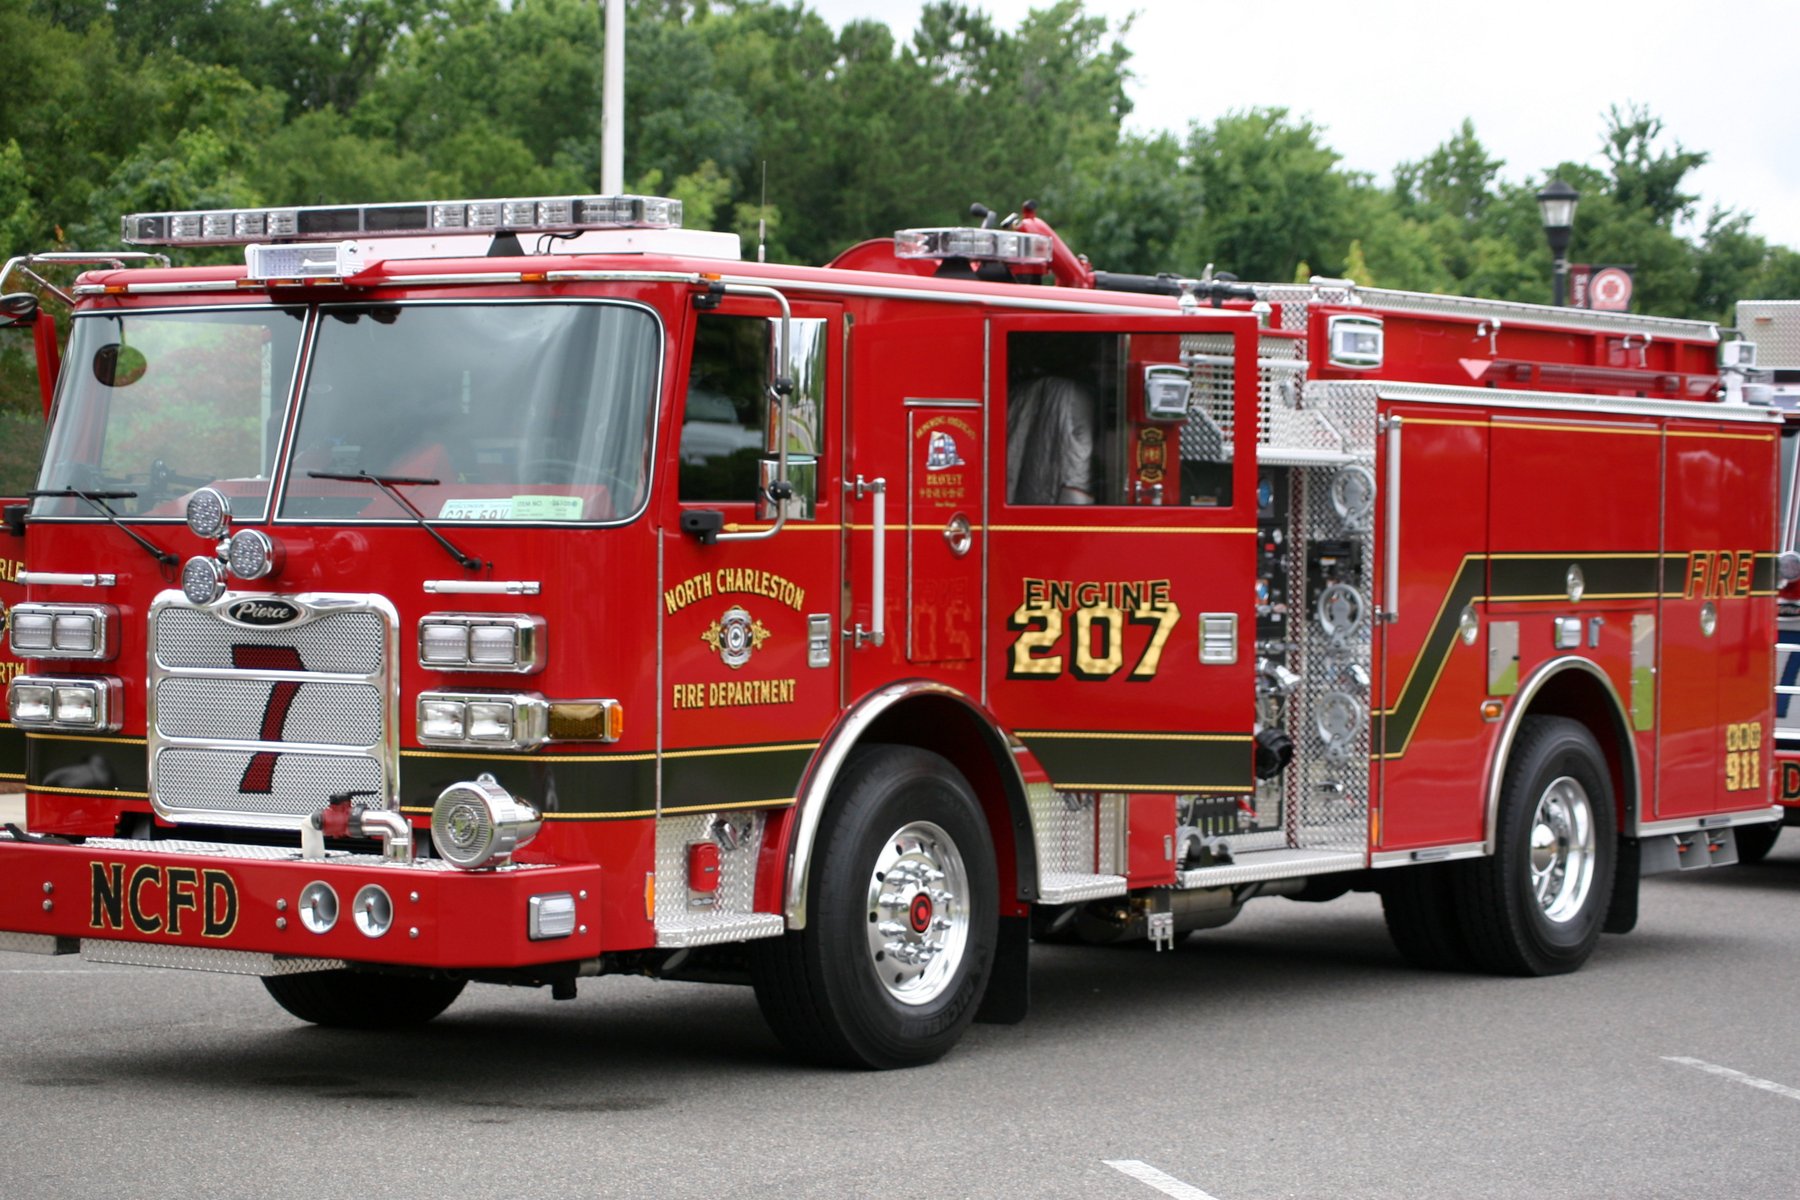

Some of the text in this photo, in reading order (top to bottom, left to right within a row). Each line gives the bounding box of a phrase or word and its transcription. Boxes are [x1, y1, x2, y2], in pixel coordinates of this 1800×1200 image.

[664, 567, 806, 615] NORTH CHARLESTON
[1022, 577, 1171, 613] ENGINE
[1684, 550, 1756, 600] FIRE
[235, 601, 290, 620] Pierce
[1005, 600, 1182, 682] 207
[673, 678, 797, 710] FIRE DEPARTMENT
[231, 643, 306, 795] 7
[1725, 751, 1761, 792] 911
[89, 861, 239, 938] NCFD
